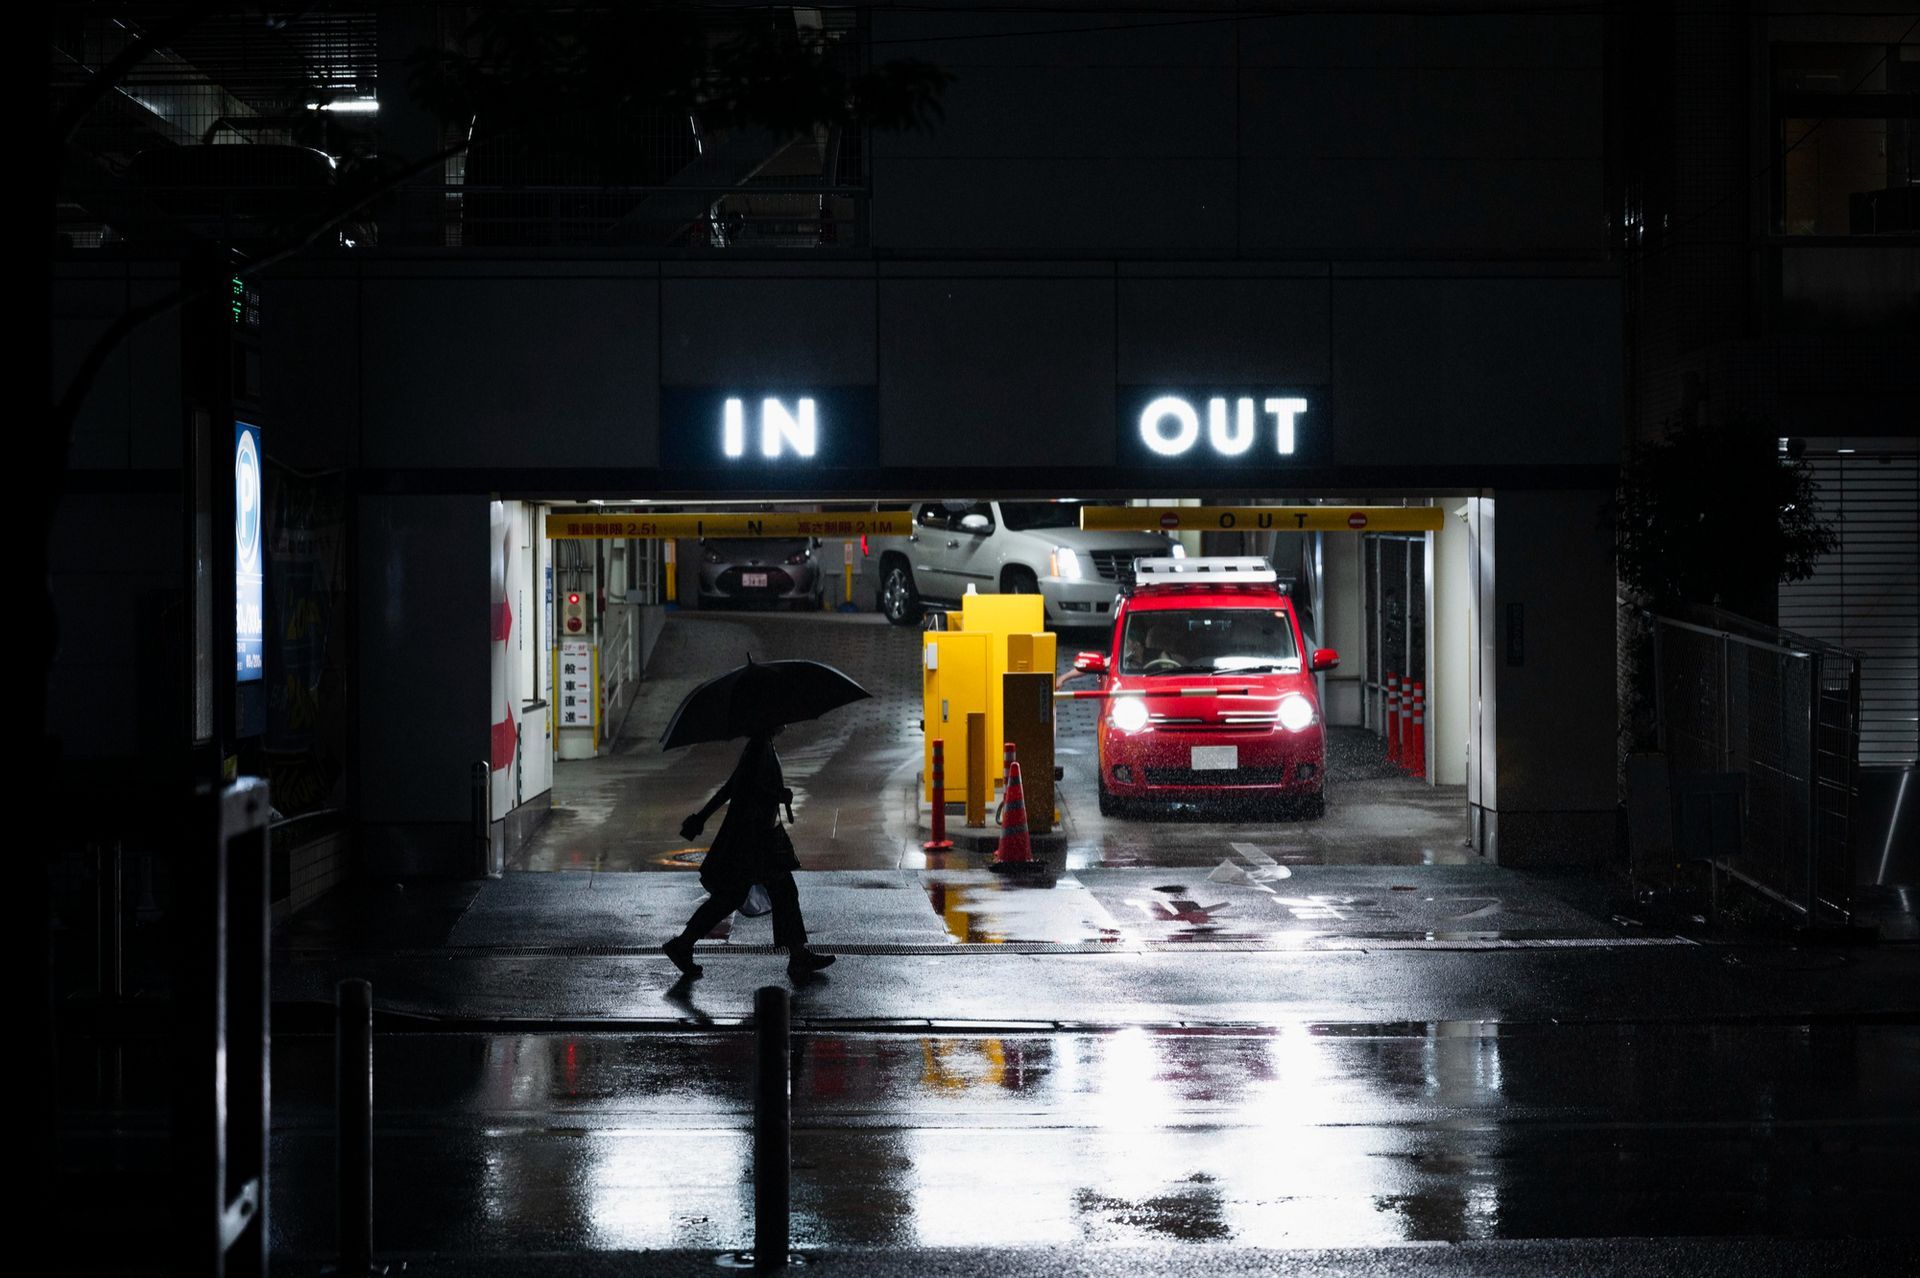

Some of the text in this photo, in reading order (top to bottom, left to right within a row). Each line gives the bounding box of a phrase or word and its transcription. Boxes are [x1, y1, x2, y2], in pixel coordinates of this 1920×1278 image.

[723, 398, 816, 458] IN
[1139, 396, 1308, 456] OUT
[855, 520, 893, 534] 2.1M
[1218, 512, 1308, 528] OUT
[627, 522, 657, 535] 2.5t
